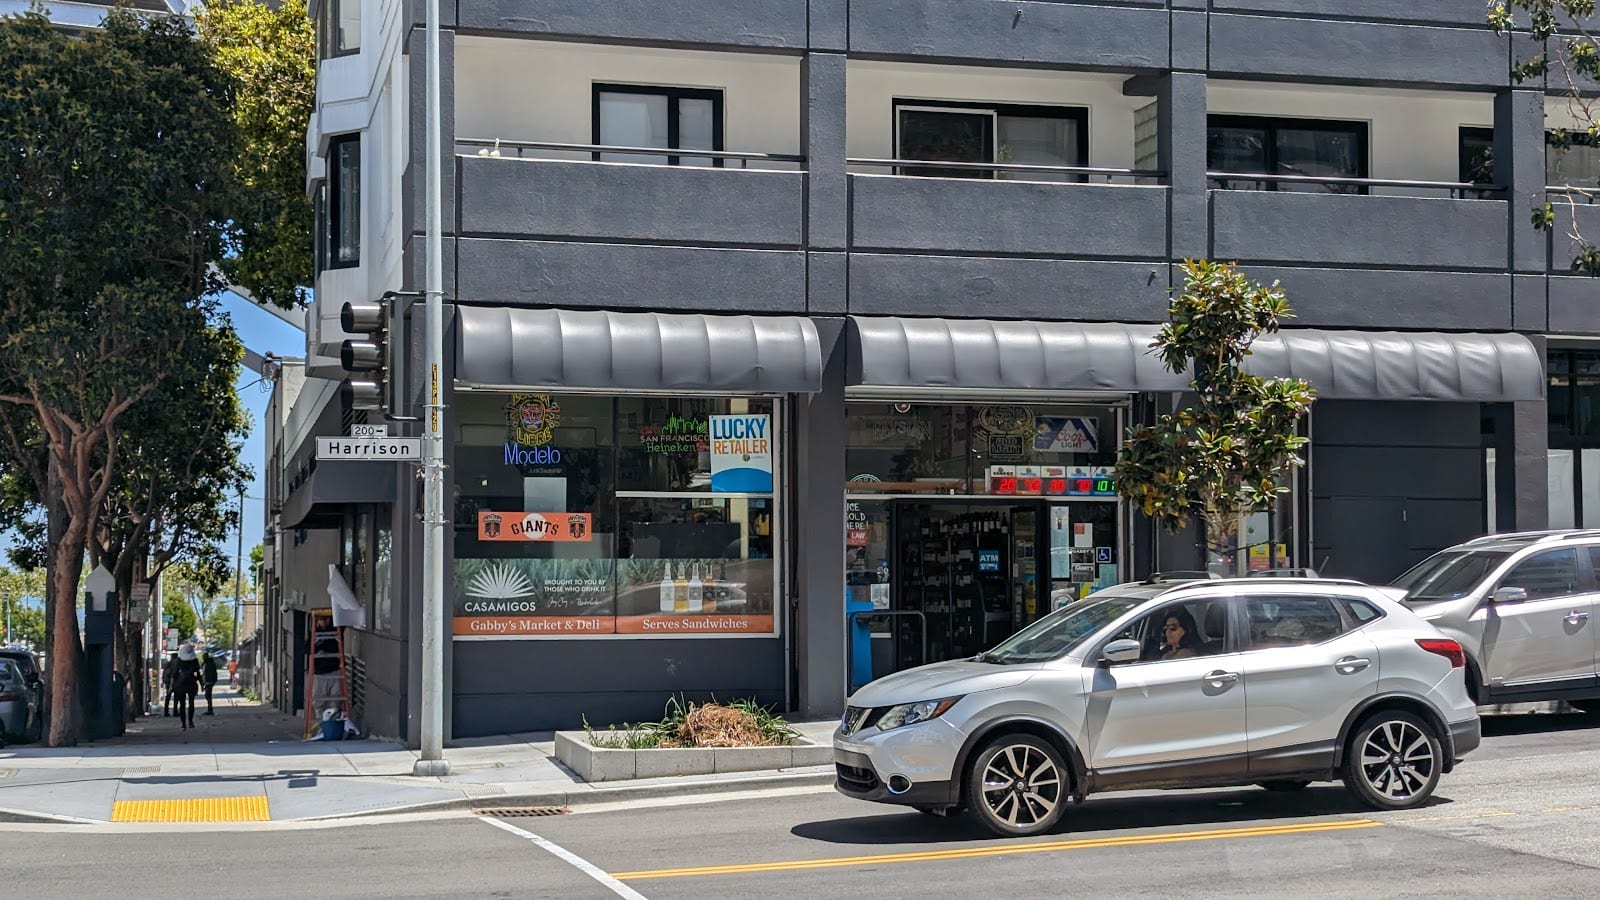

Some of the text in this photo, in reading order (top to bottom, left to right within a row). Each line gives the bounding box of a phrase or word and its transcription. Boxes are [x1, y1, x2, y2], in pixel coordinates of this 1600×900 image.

[355, 426, 375, 435] 200
[713, 418, 766, 439] LUCKY
[516, 427, 552, 446] LIBRE
[640, 434, 709, 443] SAN FRANCISCO
[1057, 429, 1088, 442] Coors
[329, 441, 409, 454] Harrison
[647, 442, 697, 453] Heineken
[714, 439, 768, 454] RETAILER
[504, 441, 560, 466] Modelo
[846, 502, 860, 512] ICE
[511, 520, 559, 535] GIANTS
[979, 554, 999, 562] ATM
[464, 602, 536, 612] CASAMIGOS
[470, 619, 600, 632] Gabby's Market & Deli
[642, 618, 748, 630] Serves Sandwiches
